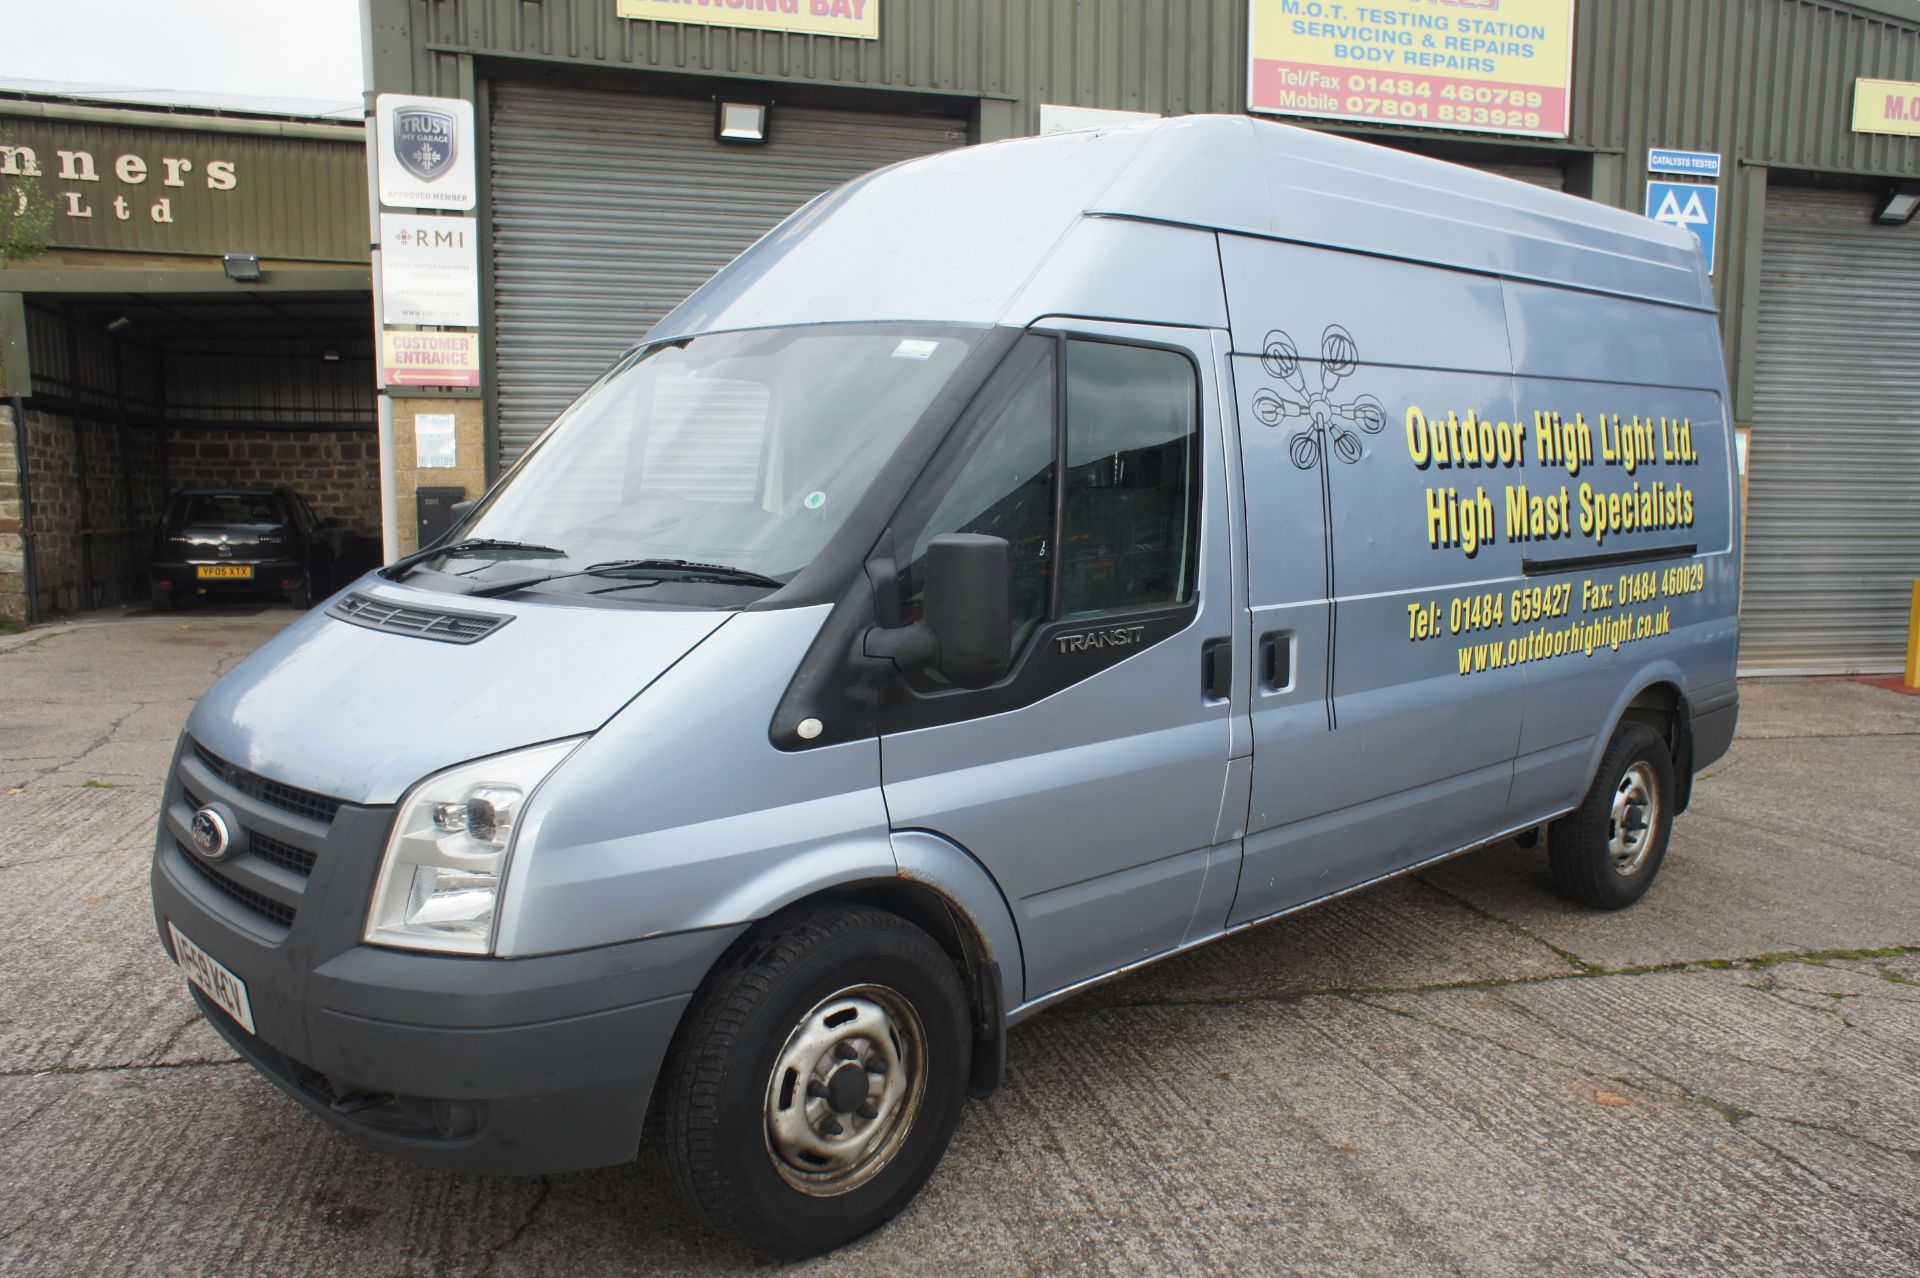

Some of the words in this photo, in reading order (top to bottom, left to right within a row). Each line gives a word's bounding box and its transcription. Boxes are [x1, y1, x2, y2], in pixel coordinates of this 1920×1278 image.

[1356, 7, 1449, 31] TESTING
[1457, 18, 1545, 40] STATION
[1291, 20, 1413, 46] SERVICING
[1422, 34, 1436, 48] &
[1445, 36, 1535, 58] REPAIRS
[1334, 44, 1395, 62] BODY
[1403, 51, 1495, 73] REPAIRS
[1278, 67, 1341, 90] Tel/Fax
[1348, 75, 1432, 98] 01484
[1440, 82, 1543, 108] 460789
[1279, 90, 1339, 111] Mobile
[1346, 97, 1429, 119] 07801
[1438, 104, 1541, 128] 833929
[402, 116, 450, 134] TRUST
[417, 134, 449, 144] GARAGE
[1652, 156, 1691, 167] CATALYSTS
[1692, 159, 1717, 169] TESTED
[65, 191, 174, 223] Ltd
[387, 190, 431, 199] APPROVED
[433, 193, 468, 202] MEMBER
[416, 229, 464, 249] RMI
[392, 336, 470, 351] CUSTOMER
[394, 351, 469, 365] ENTRANCE
[1405, 405, 1525, 467] Outdoor
[1534, 410, 1593, 474] High
[1600, 413, 1655, 473] Light
[1661, 416, 1698, 462] Ltd.
[1426, 486, 1494, 554] High
[1505, 484, 1570, 538] Mast
[1579, 481, 1695, 543] Specialists
[203, 567, 227, 576] YF05
[229, 567, 248, 576] XTX
[1407, 601, 1442, 640] Tel:
[1450, 592, 1504, 634] 01484
[1511, 582, 1572, 624] 659427
[1582, 579, 1614, 611] Fax:
[1618, 571, 1657, 605] 01484
[1661, 563, 1704, 597] 460029
[1056, 626, 1145, 653] TRANSIT
[1458, 605, 1671, 675] www.outdoorhighlight.co.uk
